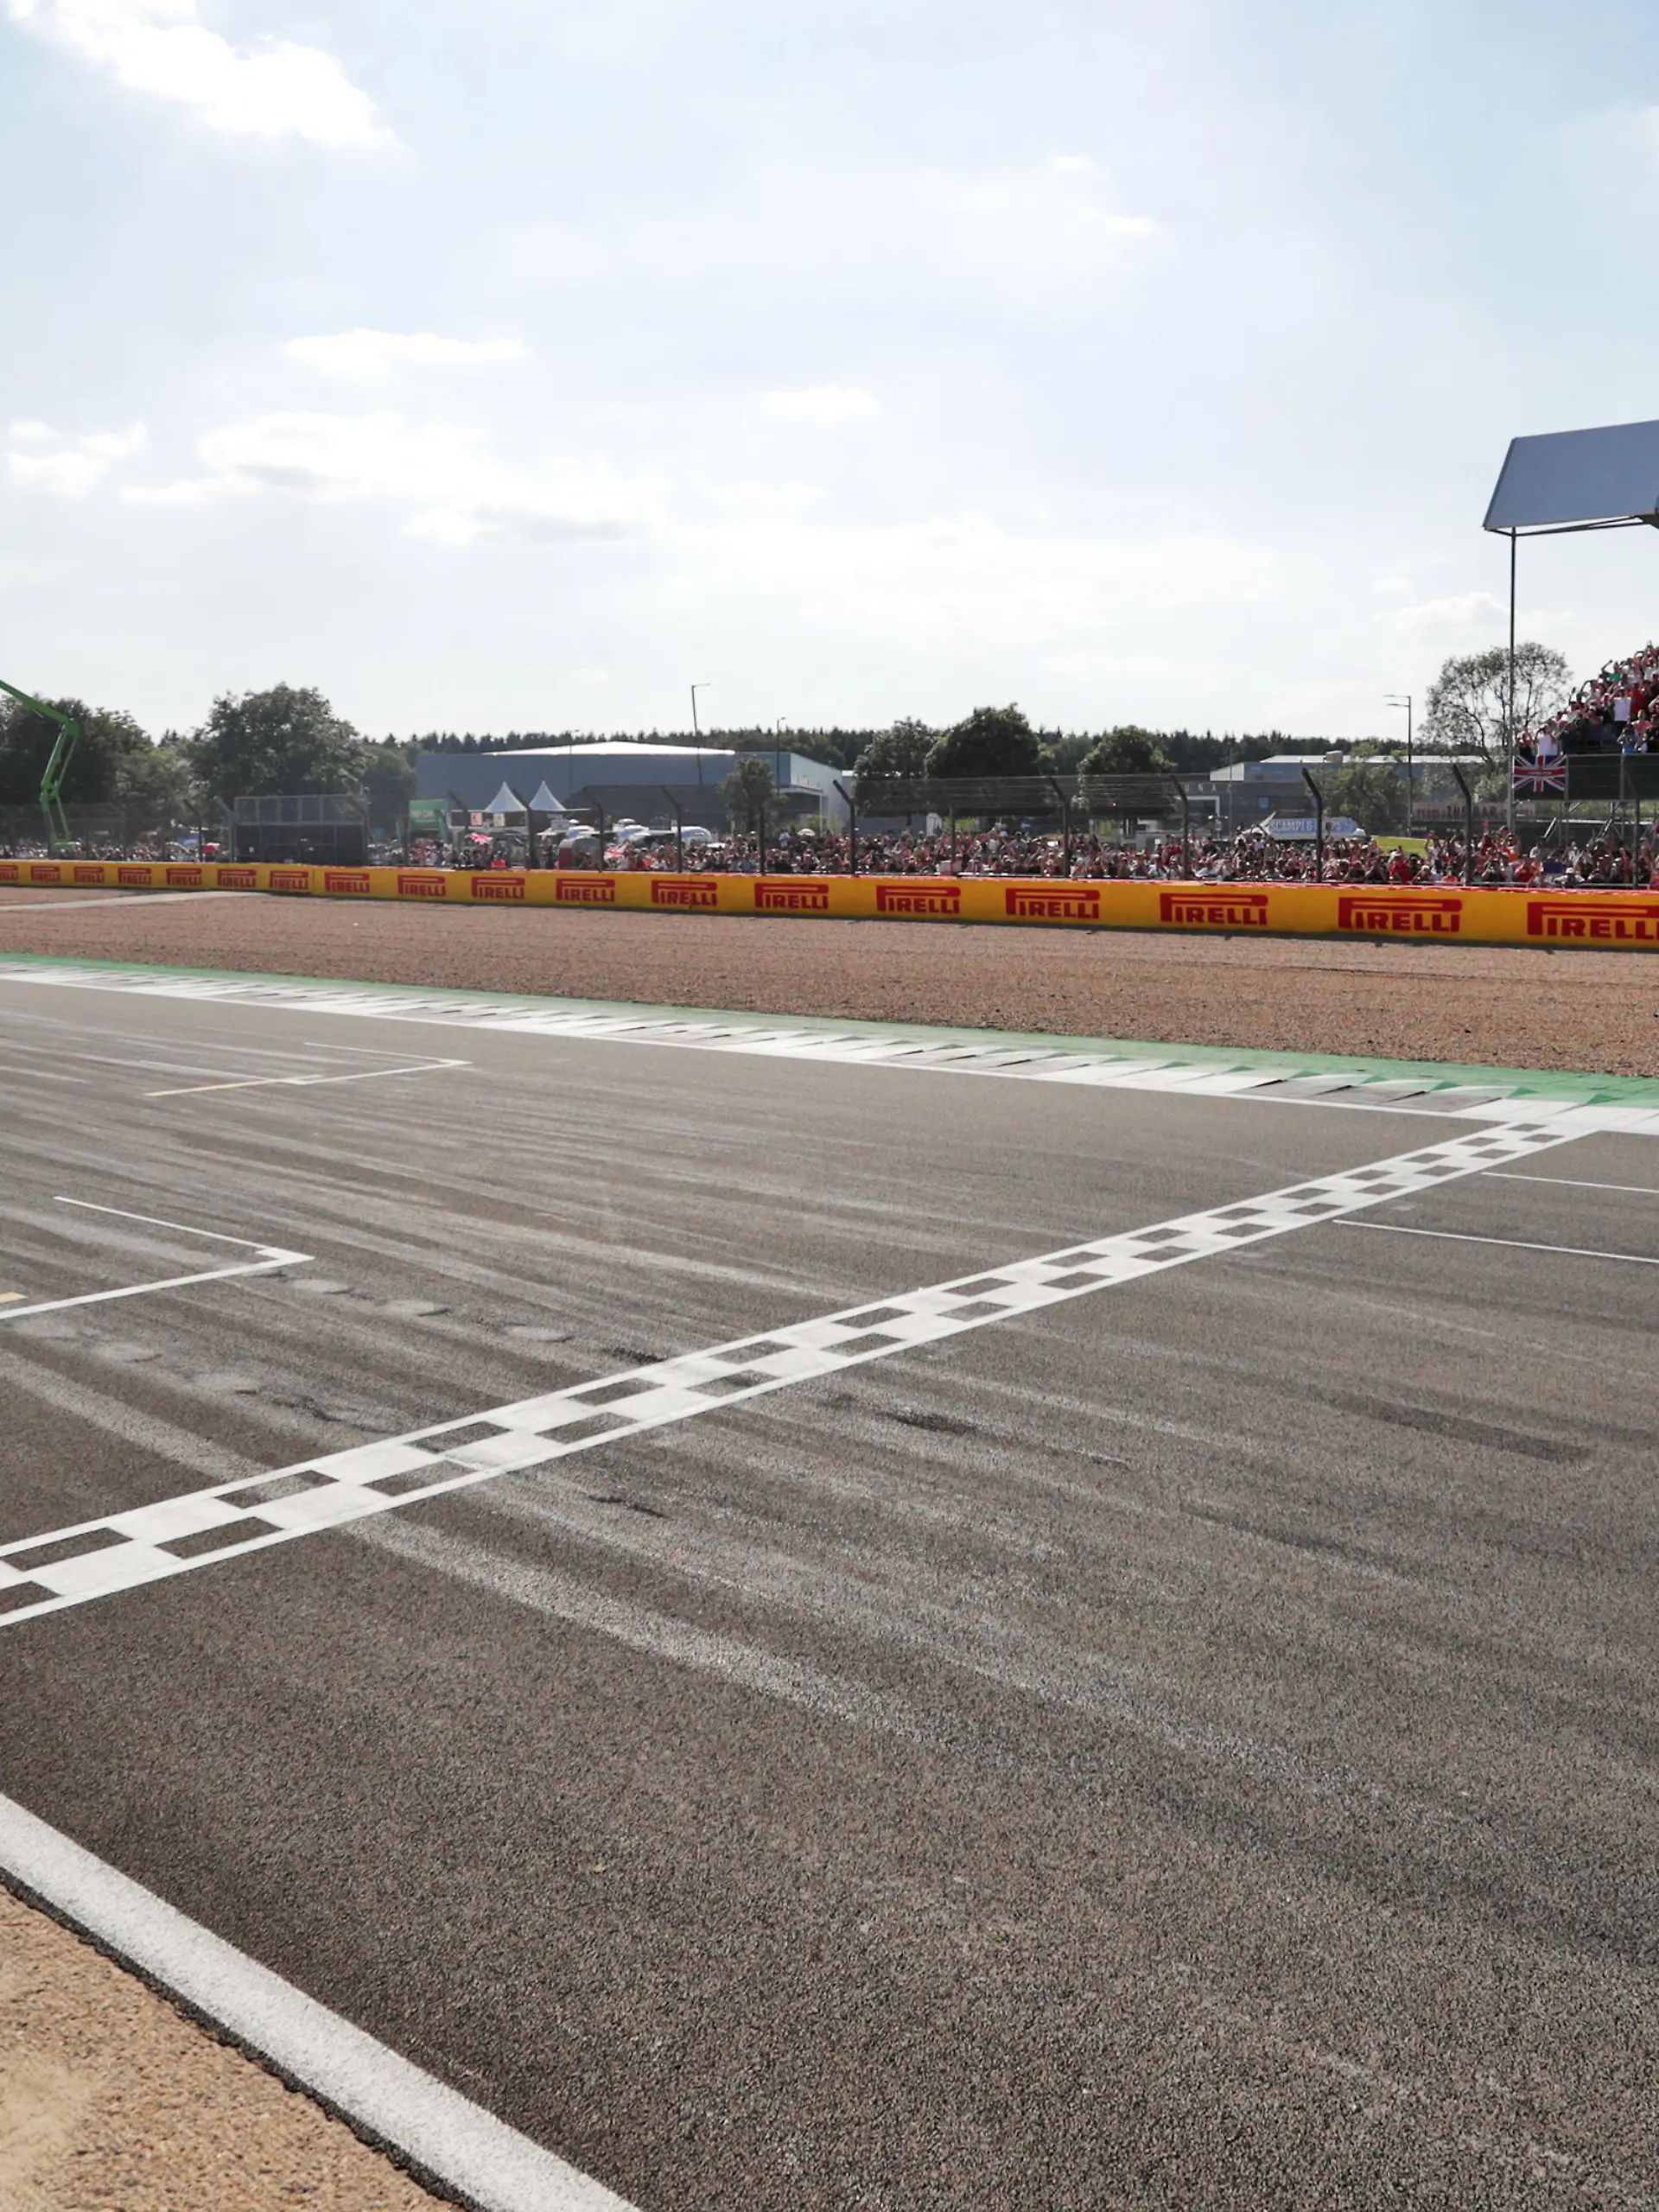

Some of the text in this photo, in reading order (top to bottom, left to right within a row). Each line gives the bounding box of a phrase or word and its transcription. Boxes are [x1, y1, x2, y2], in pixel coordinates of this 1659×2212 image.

[166, 868, 202, 887] PIRELLI
[217, 868, 257, 888] PIRELLI
[270, 870, 308, 890] PIRELLI
[324, 872, 370, 893] PIRELLI
[397, 874, 446, 897] PIRELLI
[472, 876, 525, 899] PIRELLI
[556, 878, 615, 902] PIRELLI
[652, 880, 718, 906] PIRELLI
[754, 882, 830, 910] PIRELLI
[876, 886, 961, 914] PIRELLI
[1005, 887, 1101, 919] PIRELLI
[1160, 893, 1269, 925] PIRELLI
[1338, 897, 1463, 932] PIRELLI
